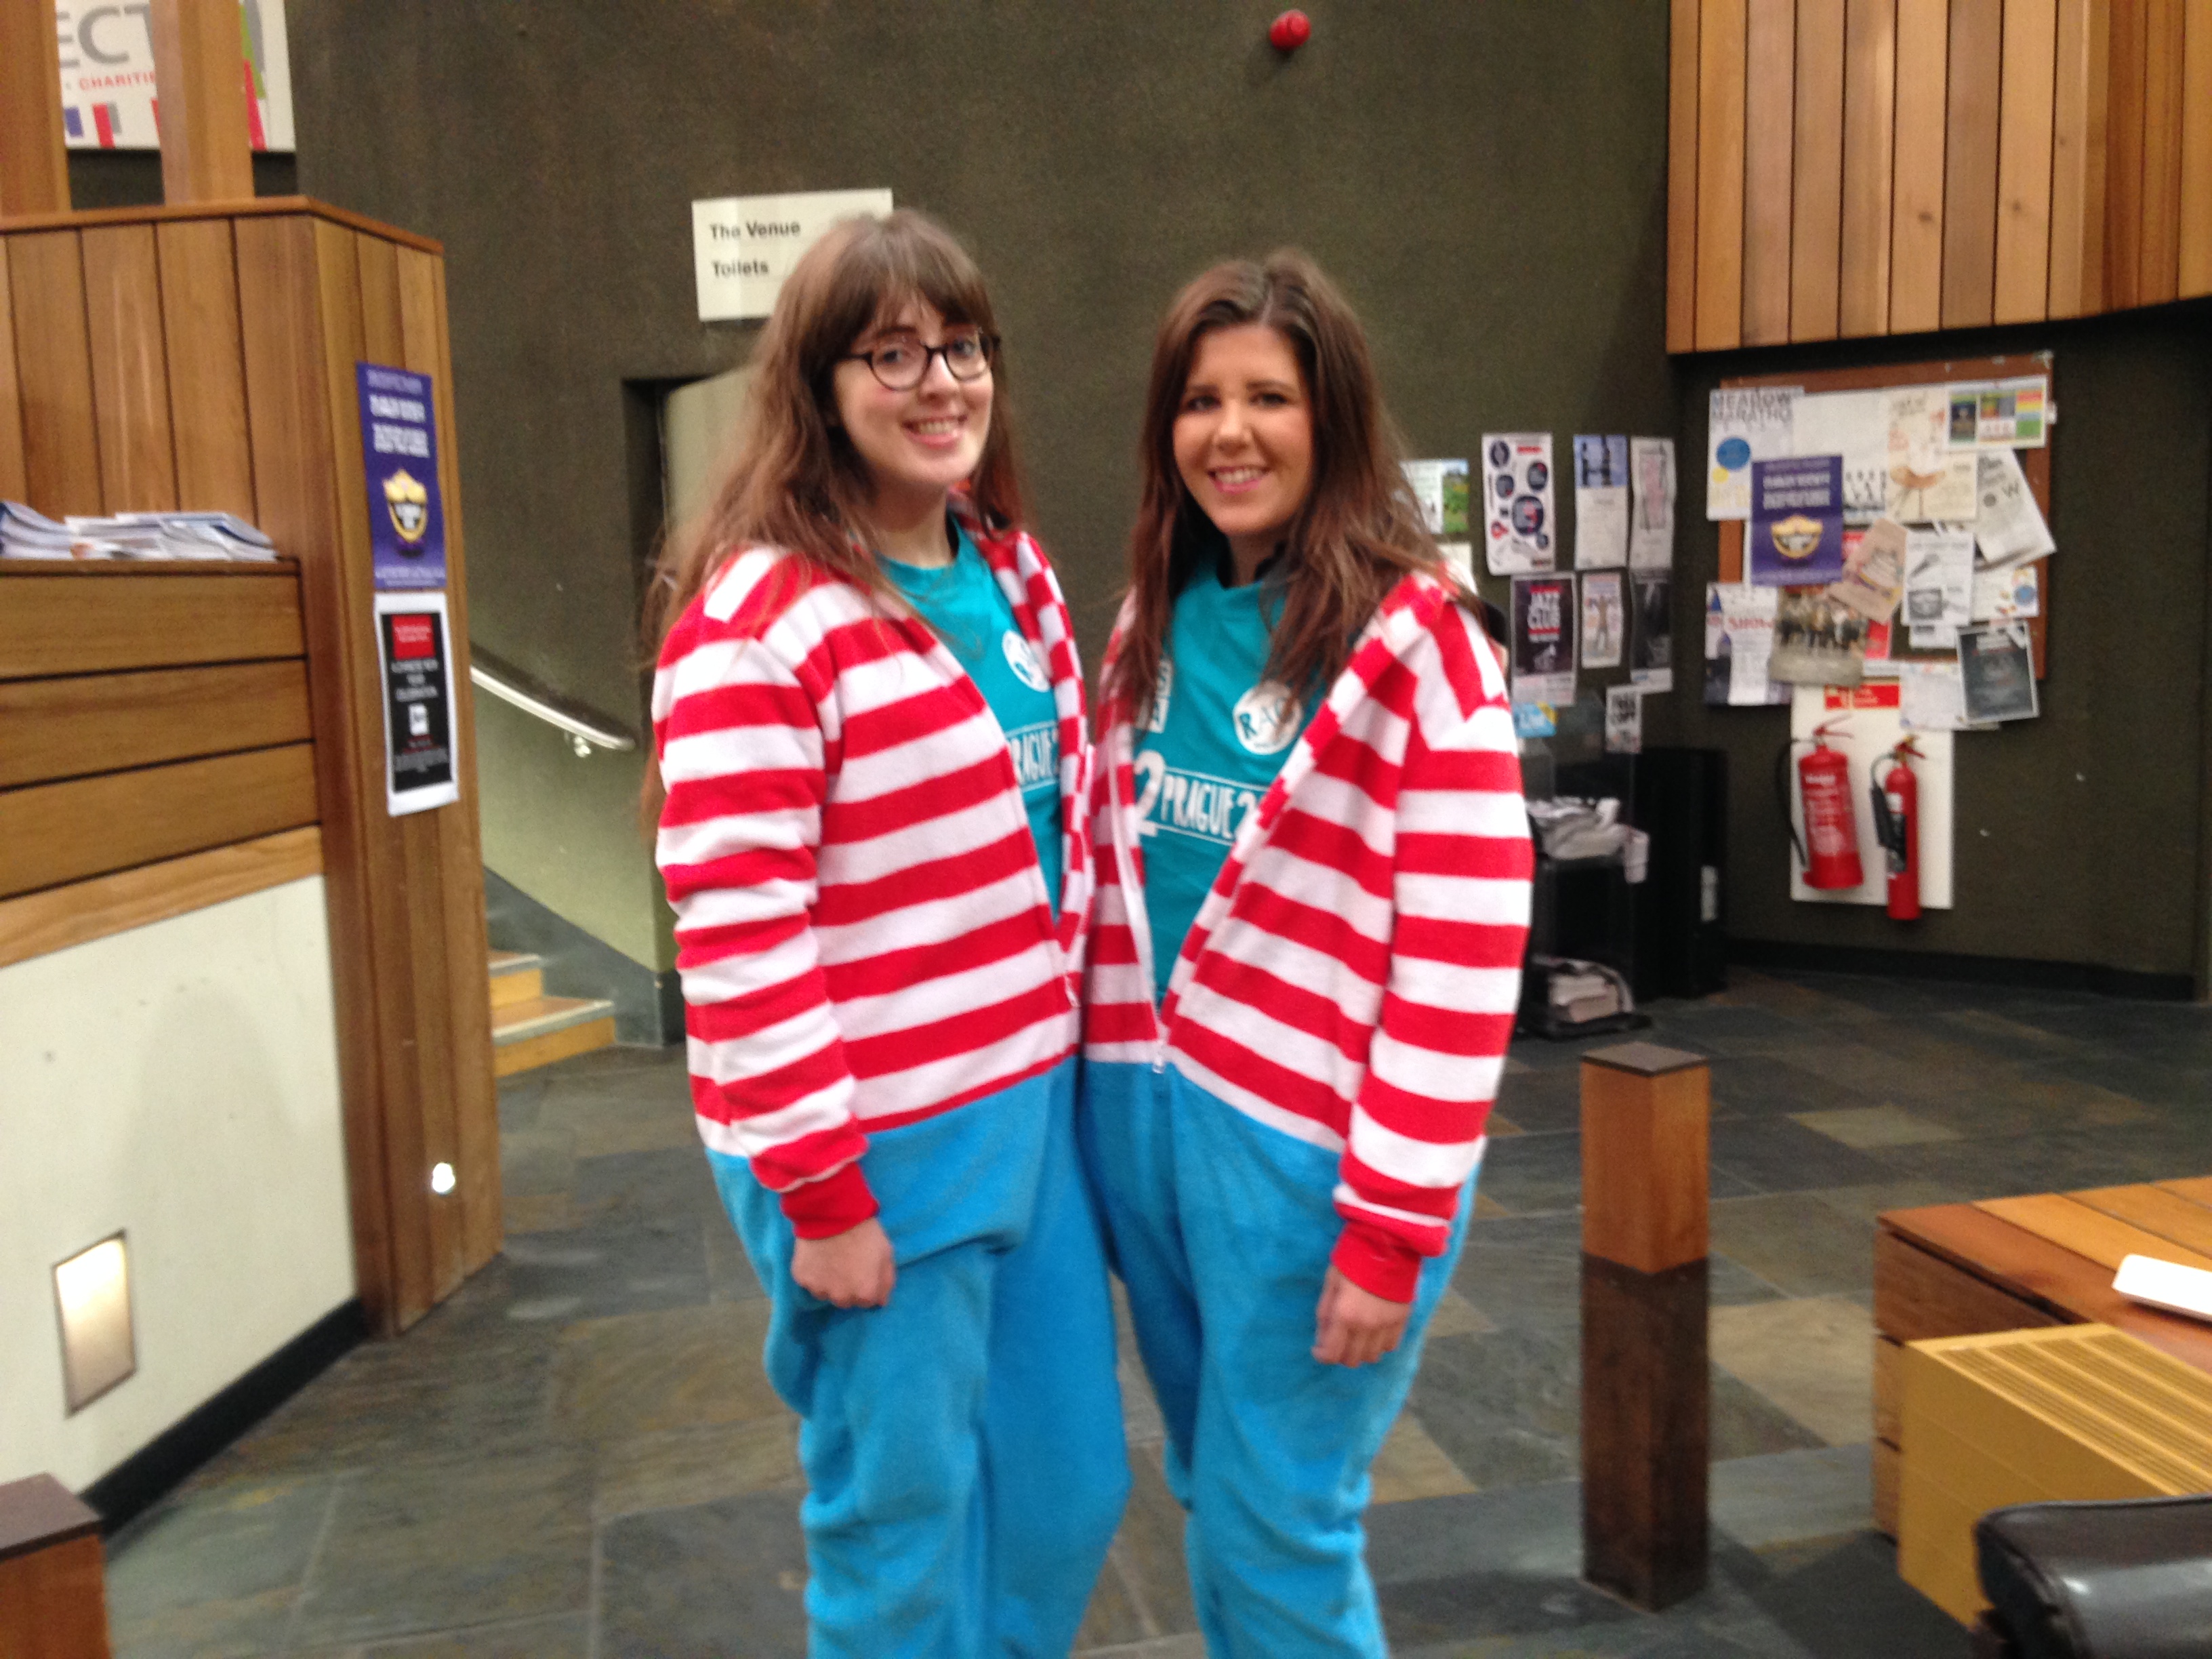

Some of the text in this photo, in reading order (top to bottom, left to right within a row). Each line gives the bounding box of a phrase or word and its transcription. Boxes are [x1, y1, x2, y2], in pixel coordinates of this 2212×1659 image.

[710, 220, 802, 239] The Venue
[712, 260, 769, 276] Toilets
[1528, 607, 1561, 628] CLUB
[1009, 729, 1052, 785] RAGUE
[1161, 774, 1235, 839] PRAGUE
